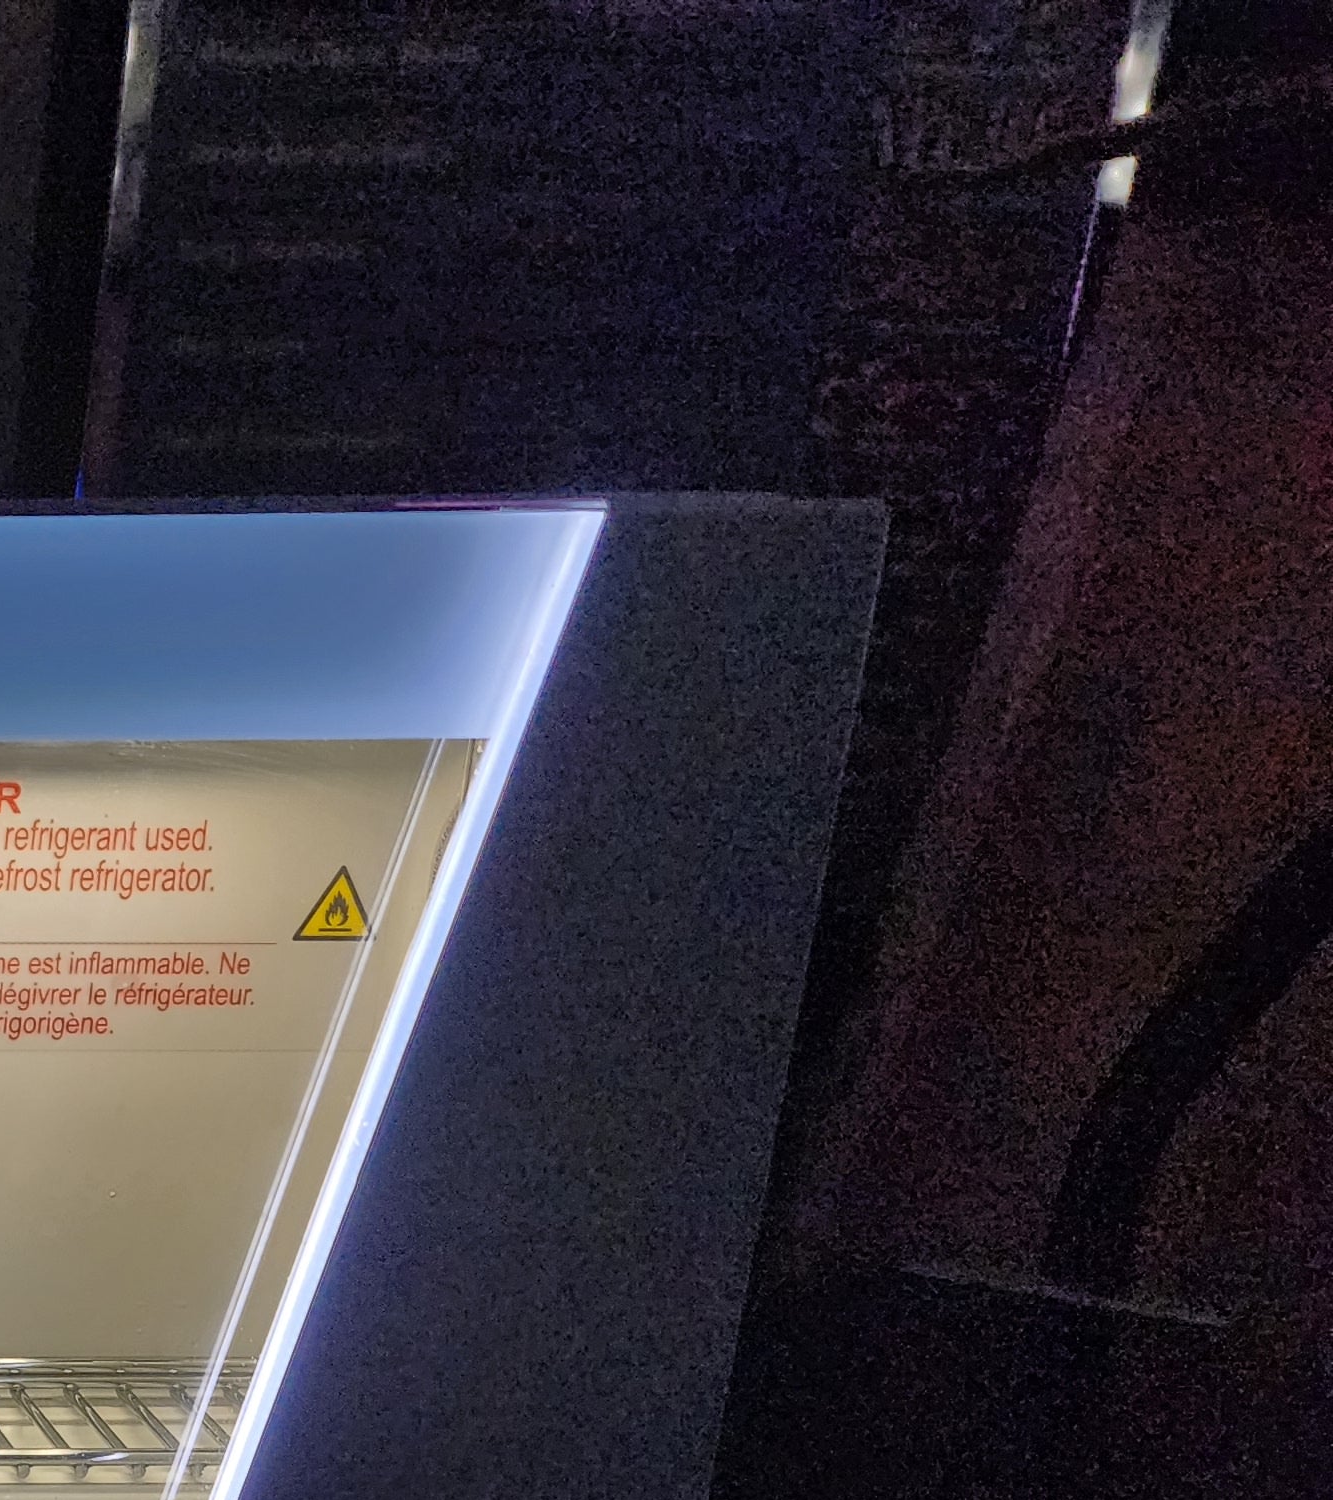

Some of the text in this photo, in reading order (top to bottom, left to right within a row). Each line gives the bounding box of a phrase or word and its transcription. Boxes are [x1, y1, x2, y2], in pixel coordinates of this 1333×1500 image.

[4, 819, 137, 858] refrigerant
[145, 819, 212, 851] used.
[69, 861, 214, 899] refrigerator.
[29, 954, 61, 975] est
[69, 952, 210, 976] inflammable.
[219, 952, 251, 975] Ne
[88, 983, 107, 1005] le
[115, 982, 255, 1011] réfrigérateur.
